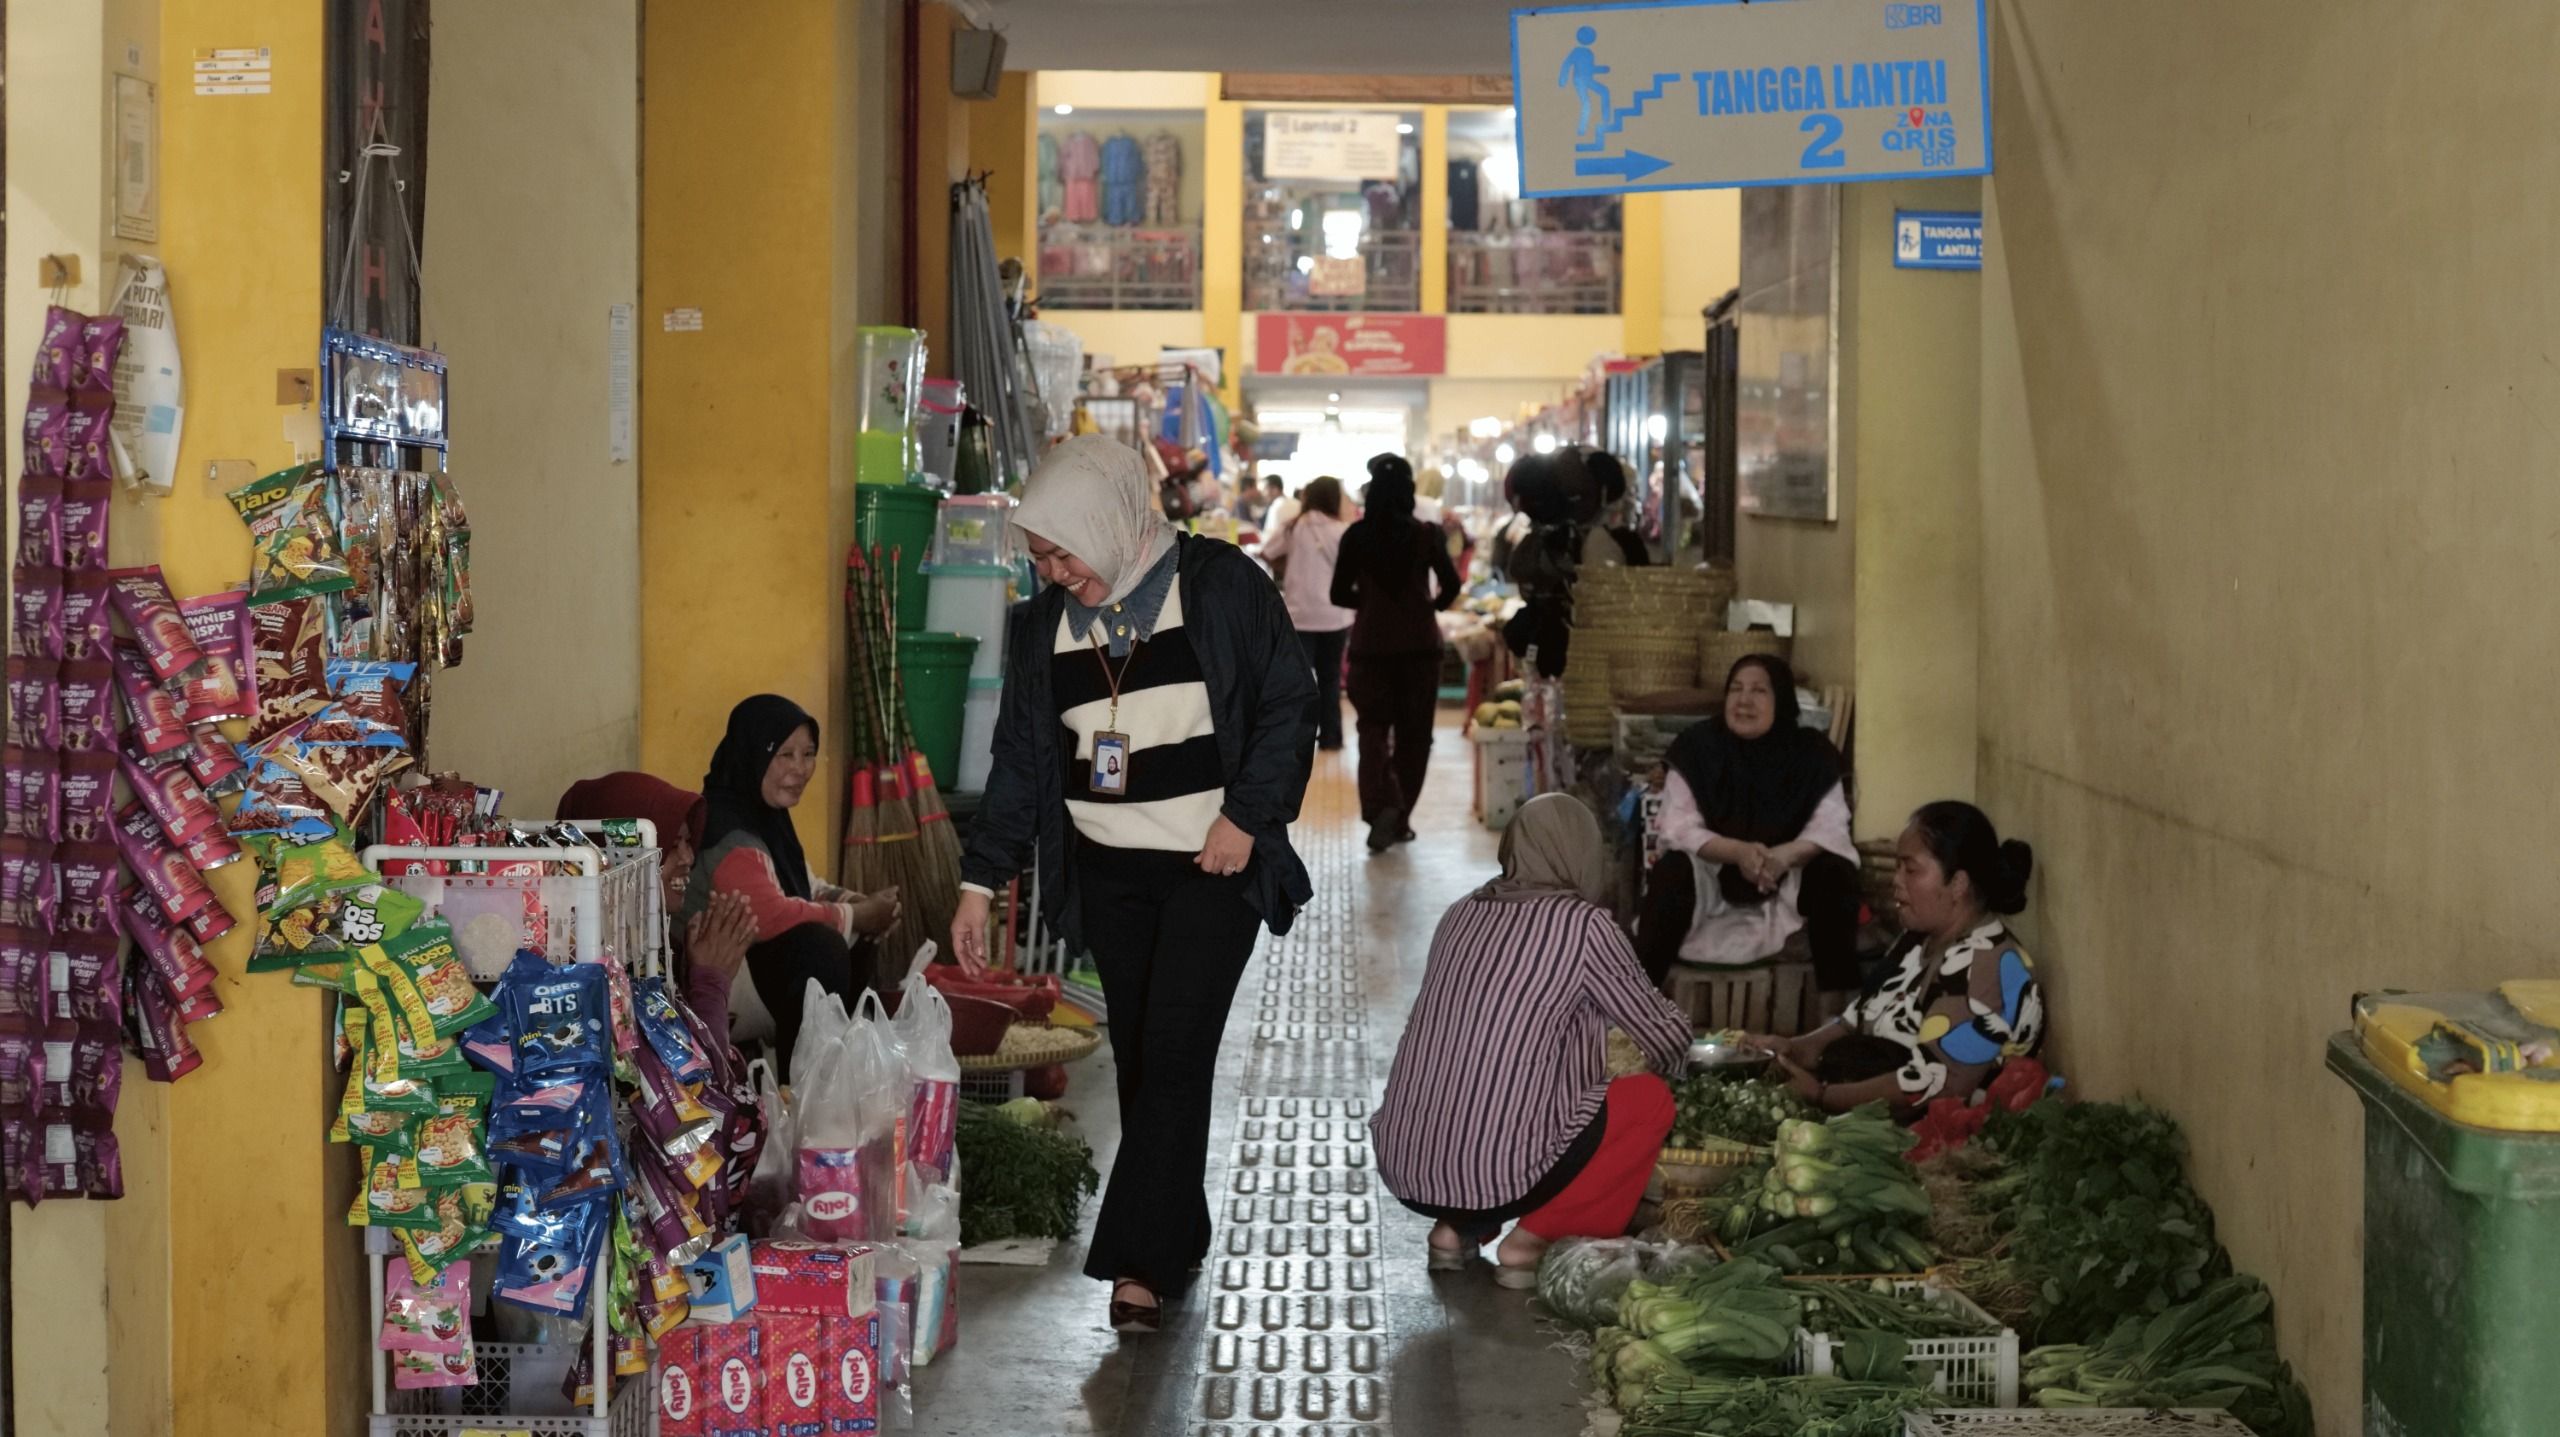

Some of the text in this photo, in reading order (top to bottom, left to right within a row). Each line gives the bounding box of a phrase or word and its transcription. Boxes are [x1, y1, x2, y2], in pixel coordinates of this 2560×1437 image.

[1692, 59, 1946, 116] TANGGA LANTAI
[1293, 118, 1358, 133] Lantai 2
[1800, 113, 1846, 169] 2
[1881, 127, 1957, 151] QRIS
[1921, 149, 1955, 167] BRI
[1923, 226, 1971, 239] TANGGA
[1937, 245, 1977, 257] LANTAI
[234, 486, 288, 513] Taro
[344, 903, 377, 925] OS
[405, 943, 453, 967] Rosta
[533, 982, 581, 996] OREO
[541, 993, 578, 1014] BTS
[519, 1030, 542, 1046] mini
[439, 1095, 477, 1108] osta
[503, 1183, 524, 1194] mini
[813, 1200, 850, 1215] jolly
[726, 1366, 746, 1405] jolly
[791, 1361, 810, 1400] jolly
[846, 1356, 865, 1395] jolly
[666, 1374, 686, 1412] jolly
